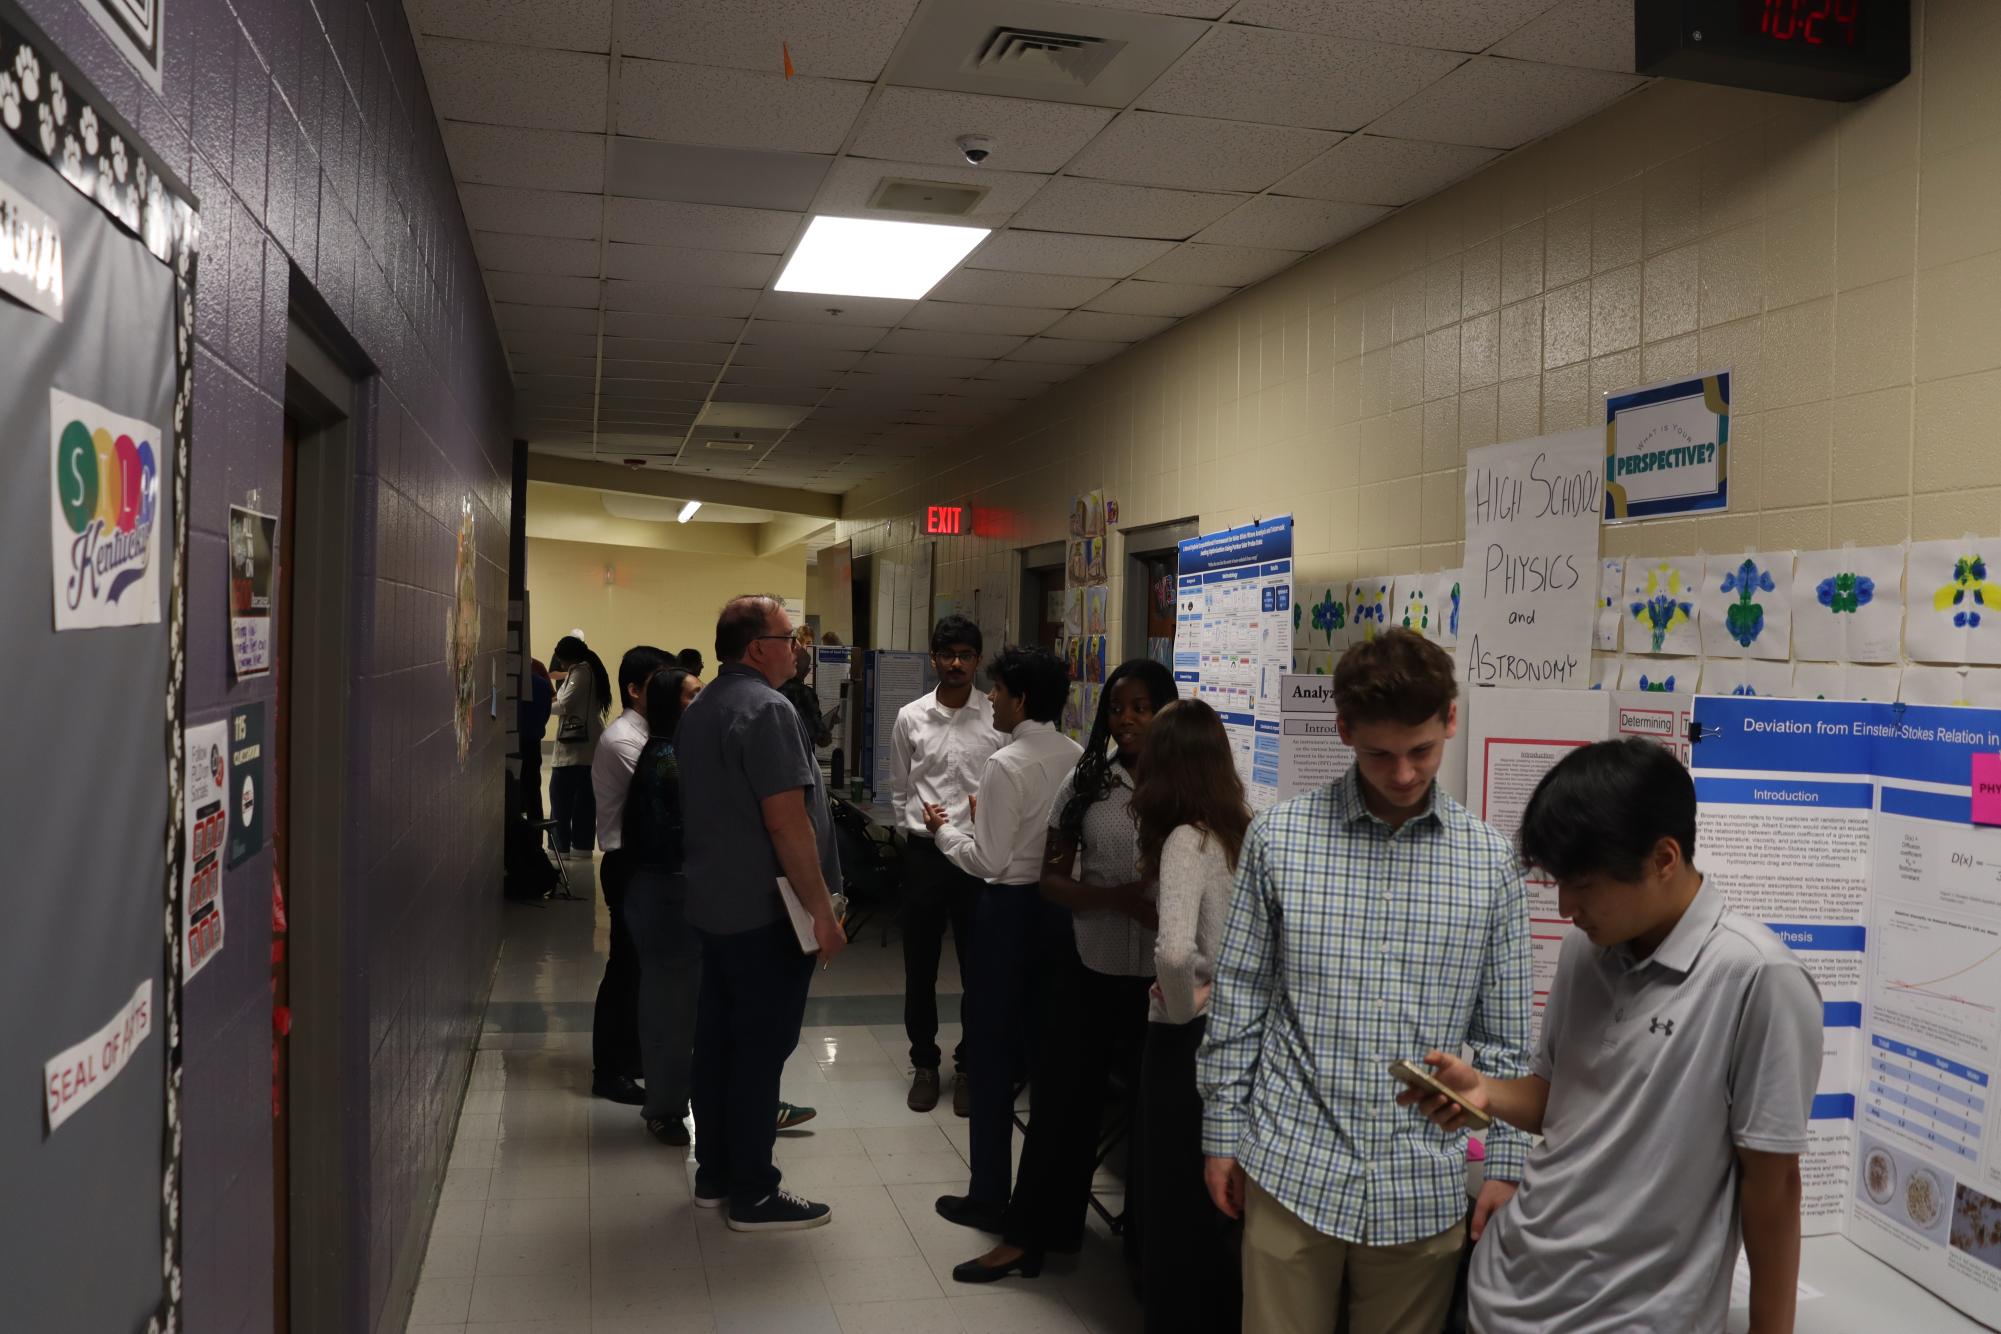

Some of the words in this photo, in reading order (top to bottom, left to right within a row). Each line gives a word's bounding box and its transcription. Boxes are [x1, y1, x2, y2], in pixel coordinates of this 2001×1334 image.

[1637, 428, 1657, 450] WHAT
[1661, 424, 1669, 432] IS
[1673, 423, 1692, 443] YOUR
[1617, 442, 1715, 477] PERSPECTIVE?
[1475, 467, 1523, 526] HIGH
[1530, 452, 1599, 519] SCHOOL
[927, 506, 962, 534] EXIT
[66, 518, 150, 611] Kentucky
[1484, 543, 1579, 599] PHYSICS
[1508, 609, 1535, 625] and
[1468, 634, 1577, 683] ASTRONOMY
[234, 715, 247, 742] 115
[1621, 714, 1671, 733] Determining
[1743, 717, 1812, 734] Deviation
[1816, 720, 1849, 735] from
[1853, 721, 1935, 741] Einstein-Stokes
[1937, 727, 1984, 745] Relation
[1988, 730, 2000, 746] in
[1754, 788, 1819, 801] Introduction
[1980, 783, 2001, 795] PHY
[1951, 852, 1973, 868] D(x)
[50, 1054, 97, 1113] SEAL
[102, 1030, 121, 1072] OF
